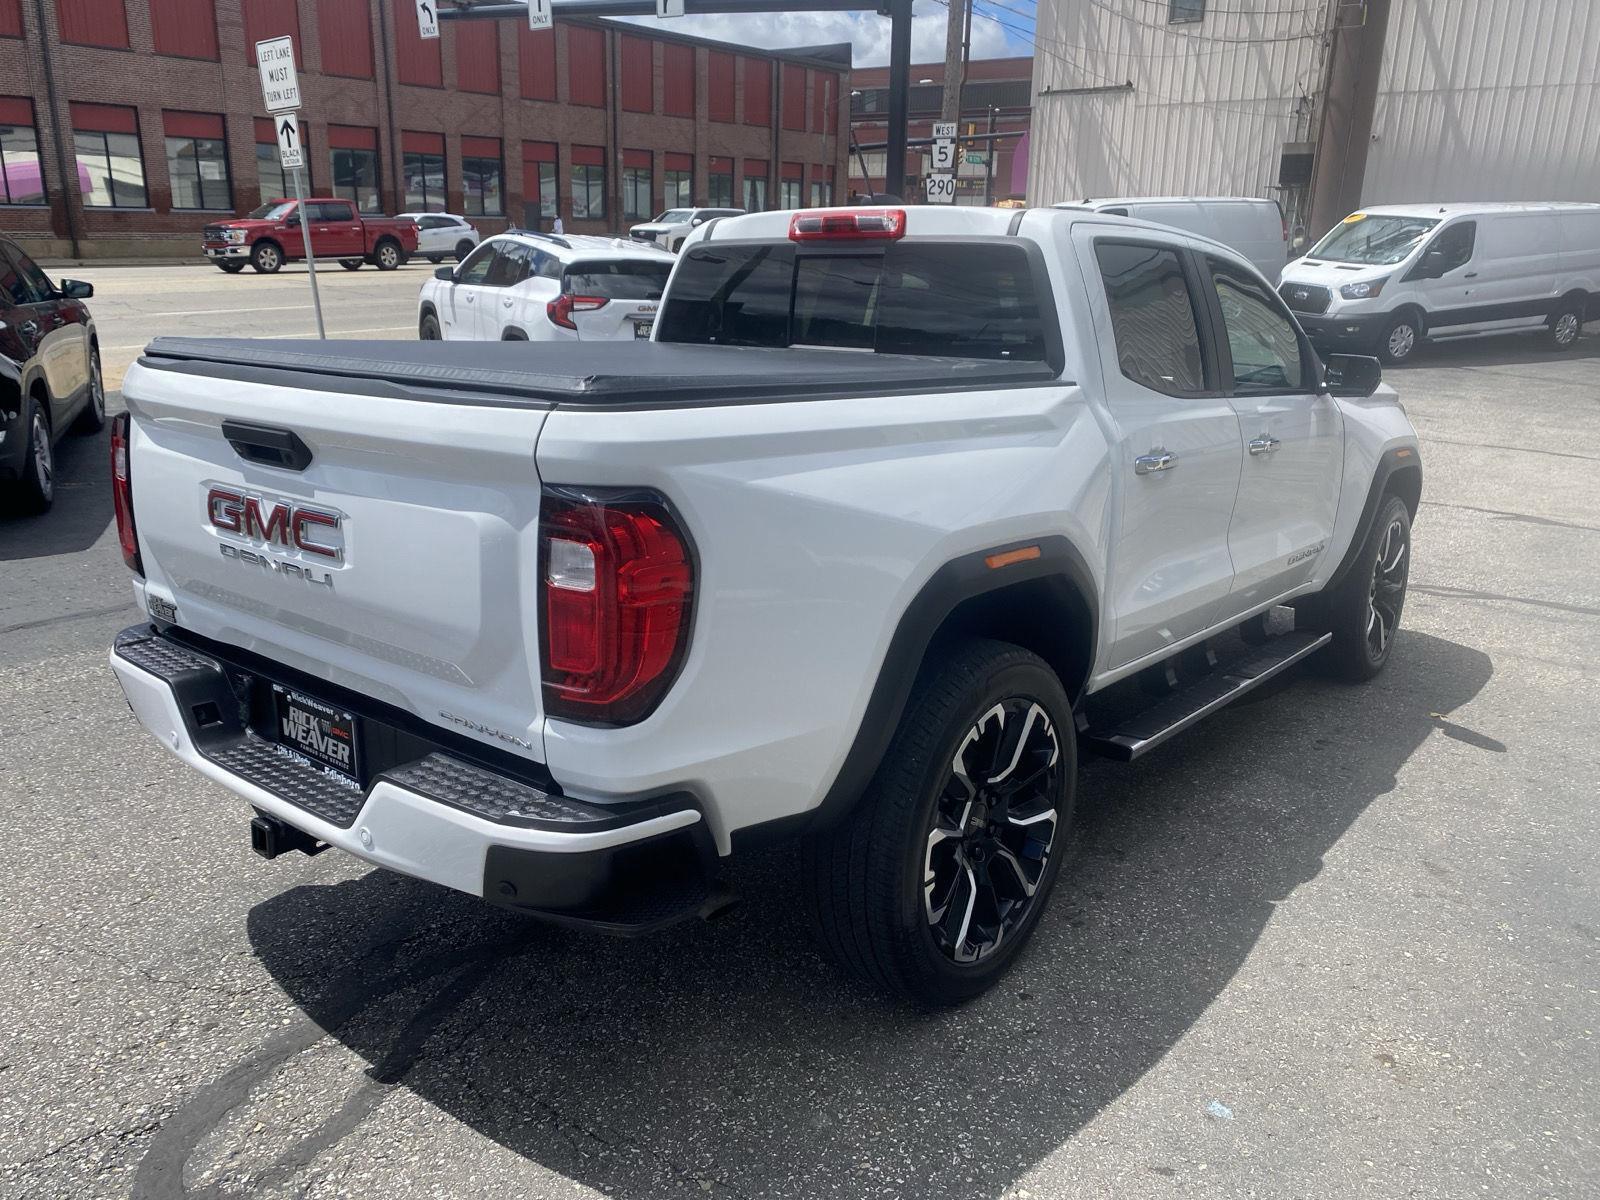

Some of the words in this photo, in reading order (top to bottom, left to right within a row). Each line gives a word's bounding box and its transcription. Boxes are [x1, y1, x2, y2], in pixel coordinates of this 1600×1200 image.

[532, 15, 548, 24] ONLY
[421, 26, 436, 35] ONLY
[260, 50, 274, 62] LEFT
[275, 46, 291, 60] LANE
[268, 67, 288, 82] MUST
[266, 91, 282, 102] TURN
[283, 87, 297, 99] LEFT
[935, 125, 955, 136] WEST
[281, 150, 300, 158] BLACK
[938, 146, 948, 162] 5
[928, 179, 954, 195] 290
[207, 485, 344, 562] GMC
[219, 543, 334, 588] DENALI
[288, 705, 320, 731] RICK
[331, 726, 350, 739] GMC
[438, 709, 532, 750] CANYON
[282, 717, 350, 764] WEAVER
[300, 743, 318, 756] FAMOUS
[319, 752, 329, 761] FOR
[329, 755, 350, 770] SERVICE
